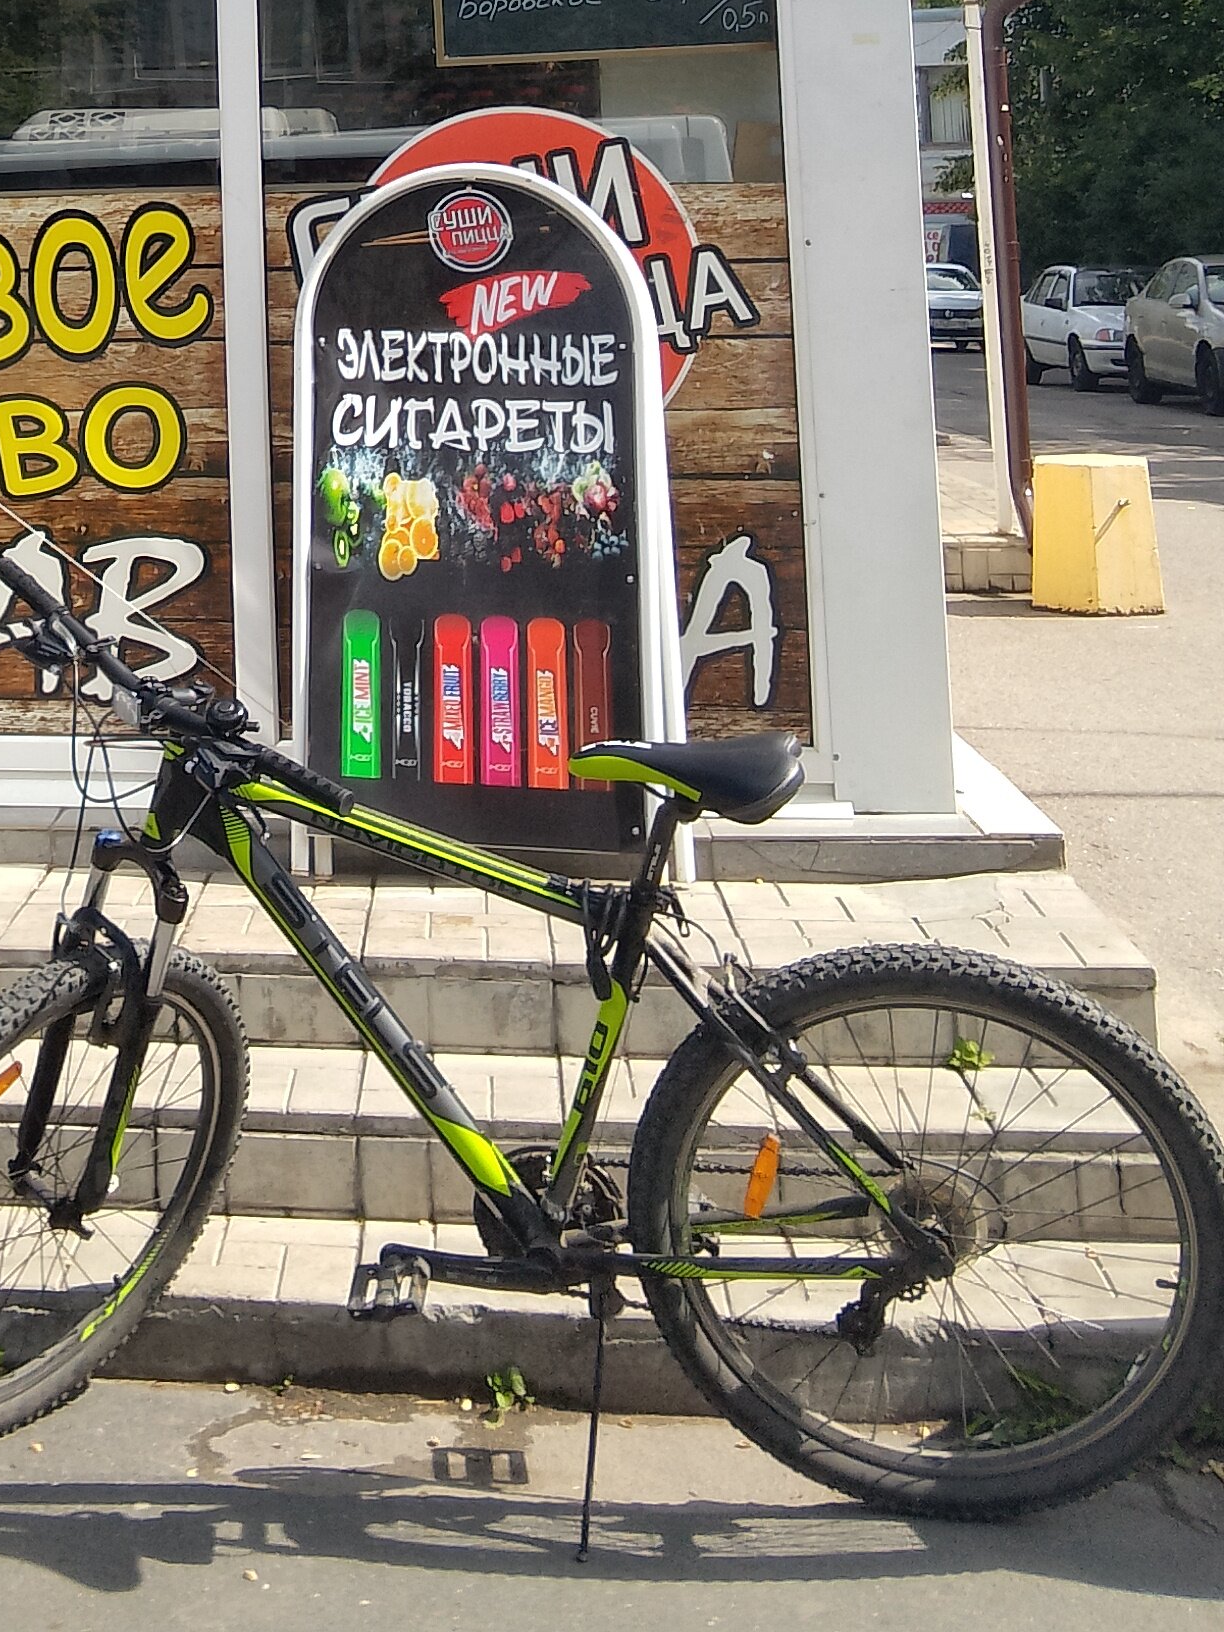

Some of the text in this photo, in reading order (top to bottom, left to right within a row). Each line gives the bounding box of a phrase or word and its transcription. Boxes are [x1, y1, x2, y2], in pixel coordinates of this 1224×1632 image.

[430, 205, 493, 232] СУШИ
[471, 272, 559, 335] NEW
[337, 328, 621, 387] ЭЛЕКТРОННЫЕ
[331, 393, 616, 454] СИГАРЕТЫ
[354, 664, 371, 701] MINT
[443, 668, 461, 698] FRUIT
[538, 674, 556, 718] MANGO
[402, 681, 413, 733] TOBACCO
